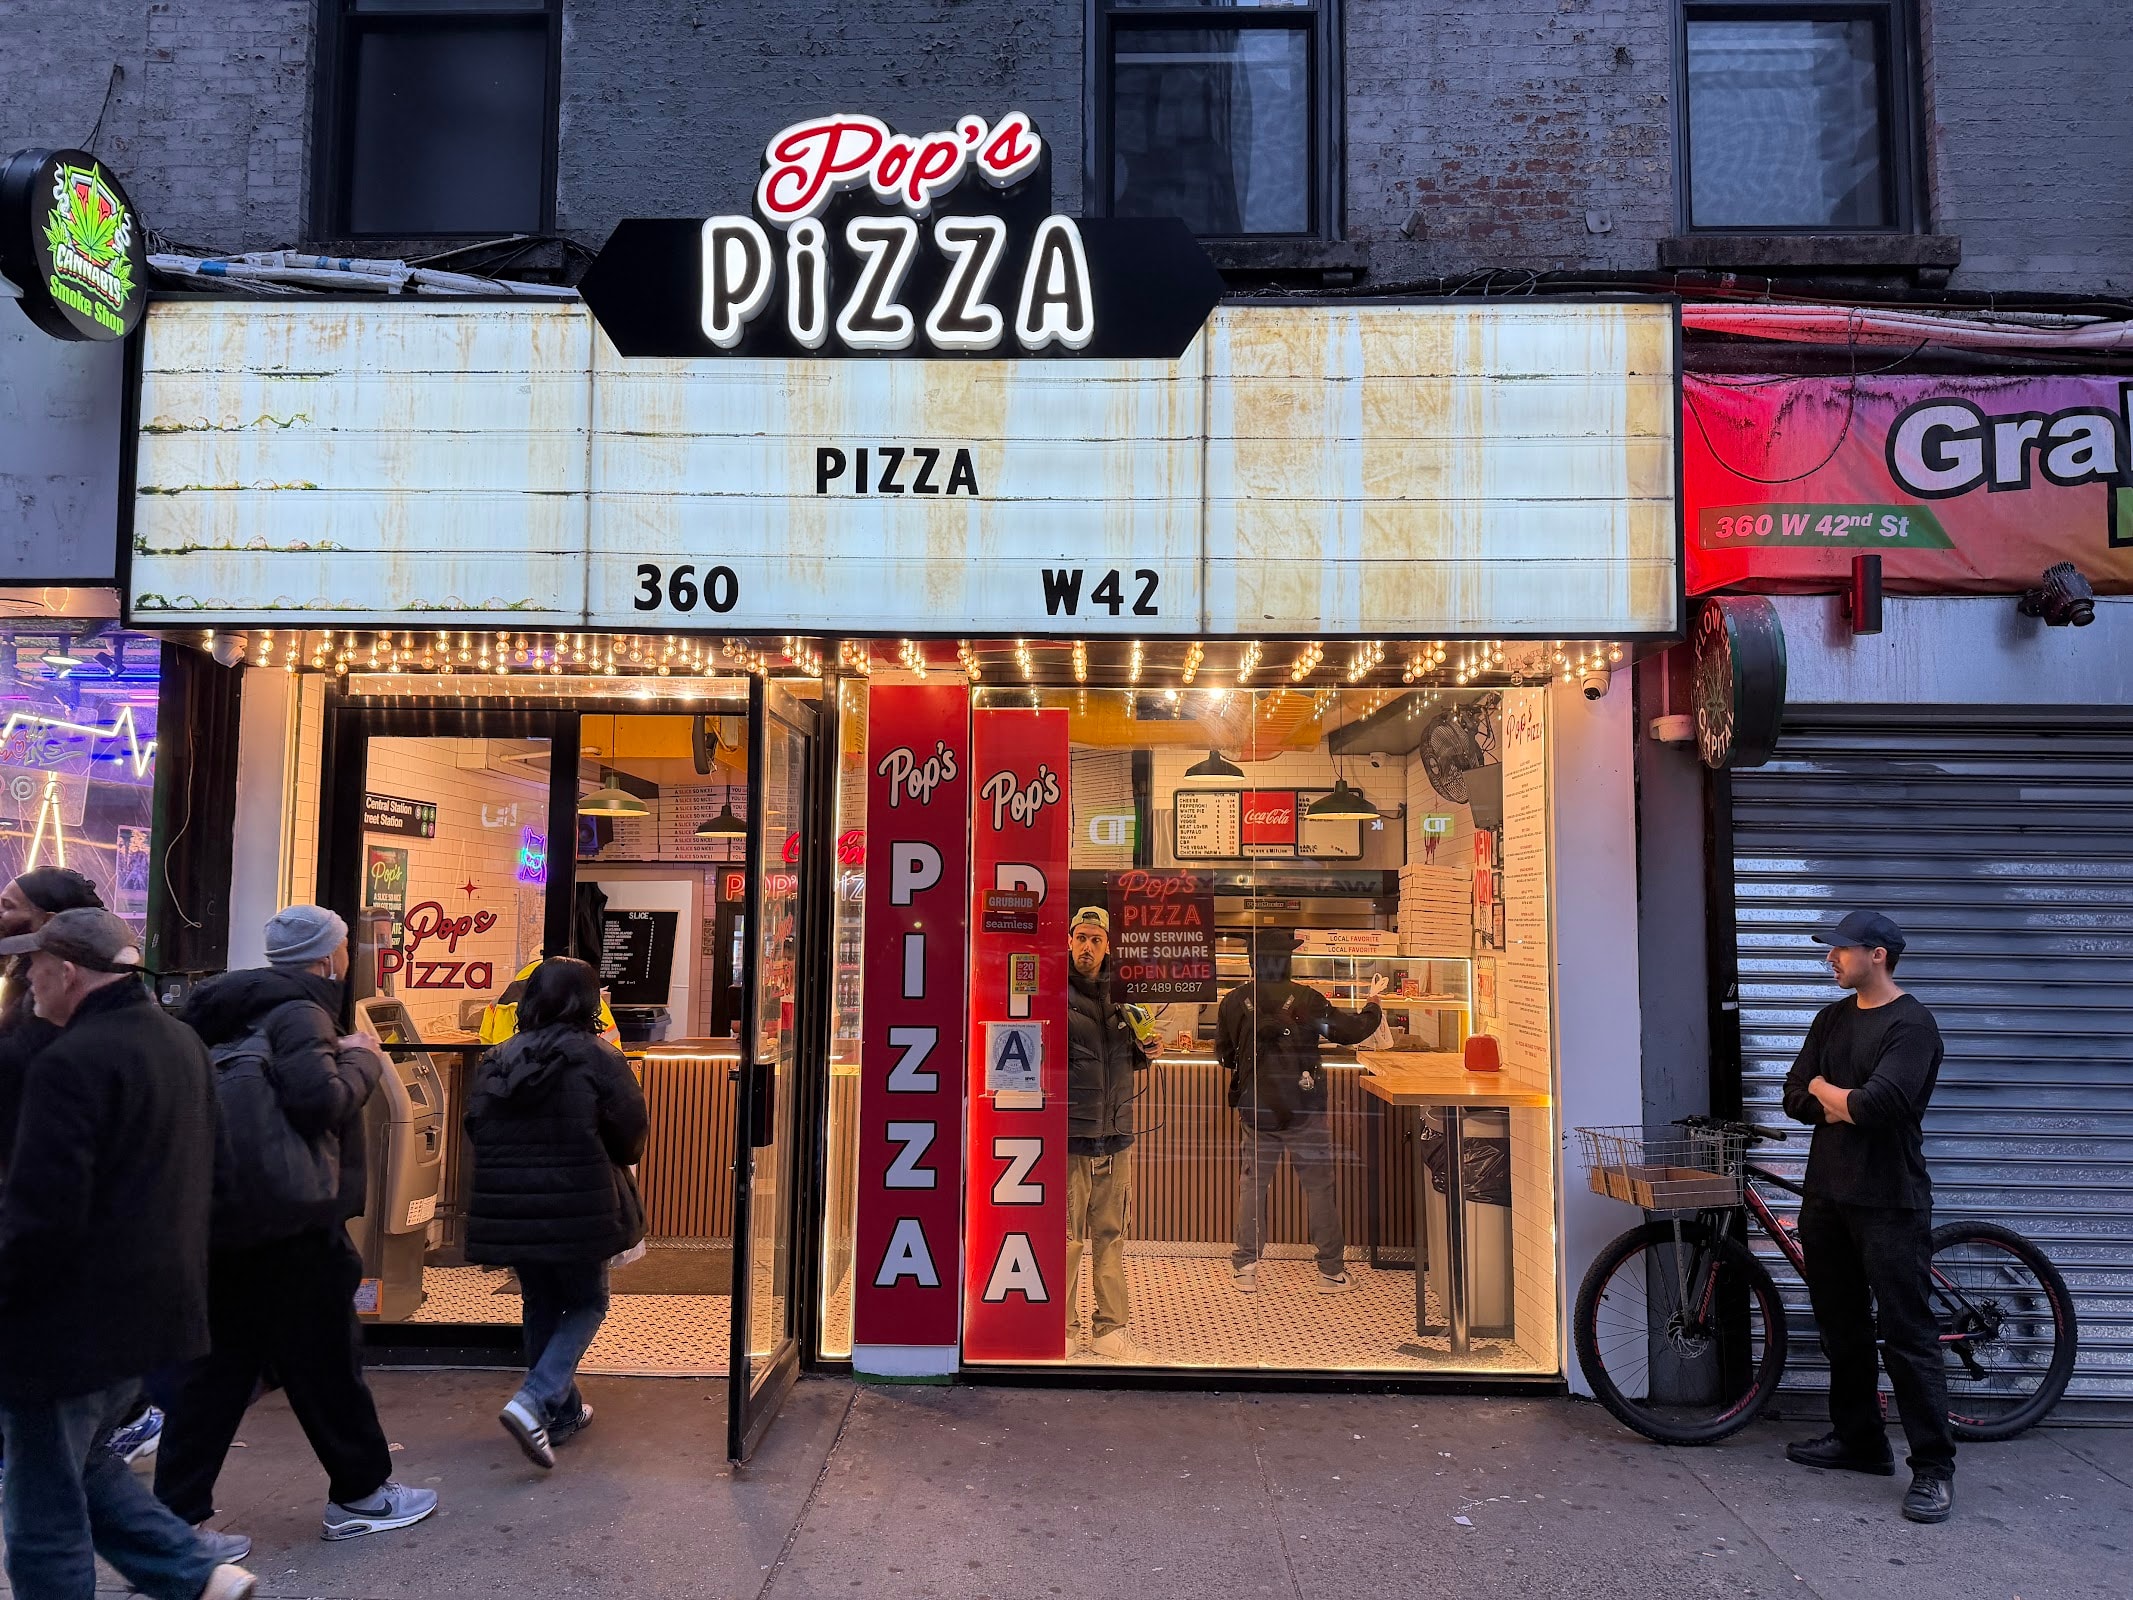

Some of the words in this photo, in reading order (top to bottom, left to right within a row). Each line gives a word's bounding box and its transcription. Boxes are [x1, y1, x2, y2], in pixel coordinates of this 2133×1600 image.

[762, 116, 1037, 217] Pop's
[56, 243, 122, 300] CANNABIS
[50, 274, 92, 316] Smoke
[94, 302, 124, 335] Shop
[1886, 383, 2133, 498] Gra
[816, 448, 979, 496] PIZZA
[1715, 514, 1773, 538] 360
[1781, 514, 1810, 536] W
[1814, 513, 1873, 537] 42nd
[1879, 515, 1910, 538] St
[634, 564, 740, 613] 360
[1695, 606, 1731, 662] FLOWER
[878, 740, 957, 808] Pop's
[366, 796, 389, 812] Central
[390, 801, 412, 815] Station
[981, 764, 1060, 831] Pop's
[364, 811, 380, 825] treet
[380, 814, 403, 828] Station
[371, 861, 402, 890] Pop's
[1118, 868, 1198, 902] Pop's
[988, 896, 1033, 908] GRUBHUB
[1124, 904, 1202, 926] PIZZA
[392, 923, 402, 934] ATE
[986, 920, 1033, 930] seamless
[1122, 932, 1150, 943] NOW
[1154, 931, 1204, 942] SERVING
[377, 948, 493, 990] Pizza
[1116, 947, 1148, 958] TIME
[1152, 946, 1209, 958] SQUARE
[1120, 965, 1166, 979] OPEN
[1172, 964, 1210, 979] LATE
[1127, 983, 1148, 993] 212
[1151, 982, 1172, 992] 489
[1175, 982, 1202, 992] 6287
[873, 840, 944, 1288] PIZZA
[995, 1030, 1032, 1072] A
